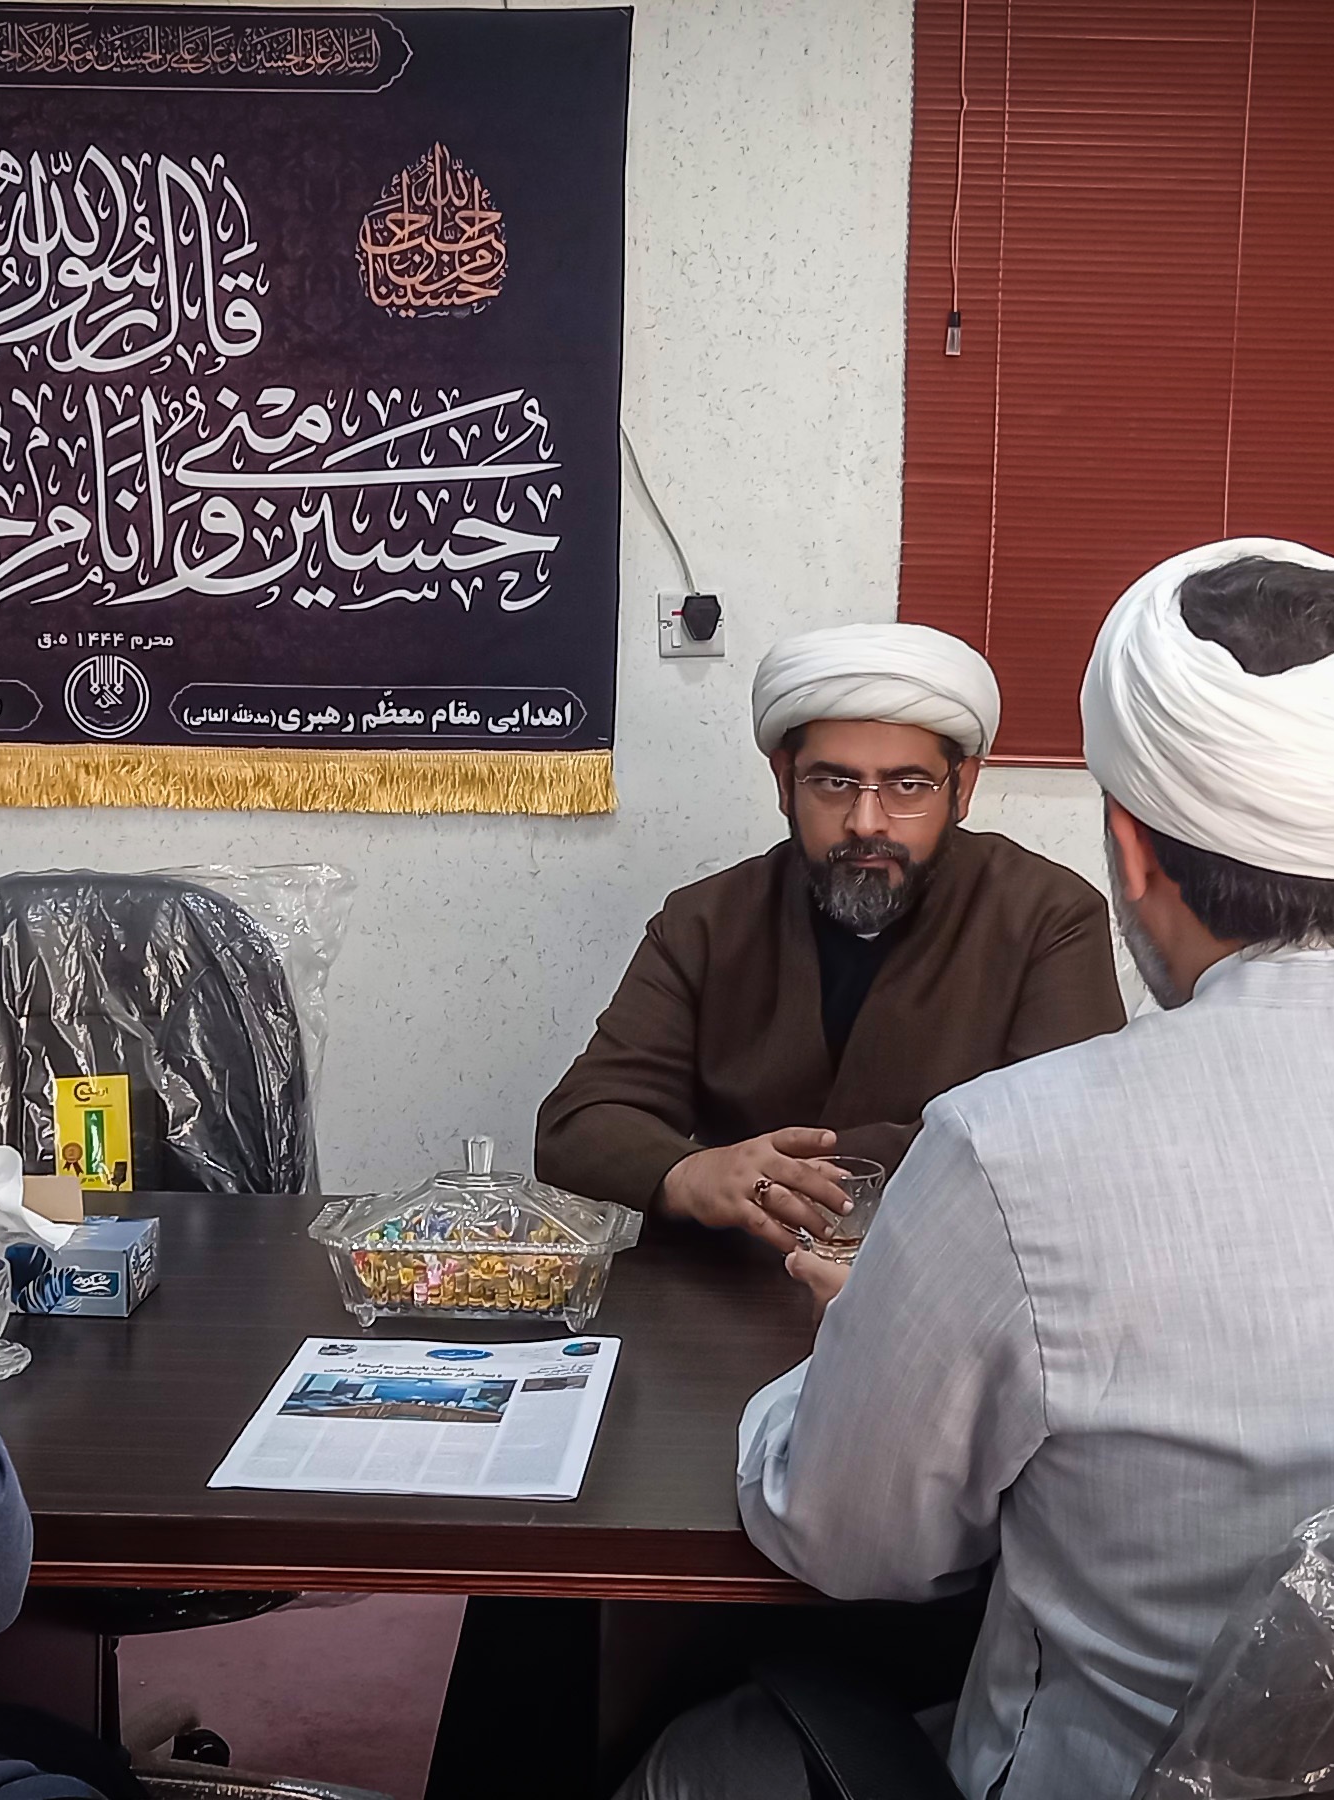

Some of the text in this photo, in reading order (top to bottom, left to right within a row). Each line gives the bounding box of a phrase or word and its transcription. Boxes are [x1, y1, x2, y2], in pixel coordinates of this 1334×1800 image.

[78, 632, 125, 647] ۱۴۴۴
[130, 636, 174, 650] محرم
[278, 703, 356, 734] رهبری
[431, 700, 481, 732] مقام
[487, 701, 572, 734] اهدایی
